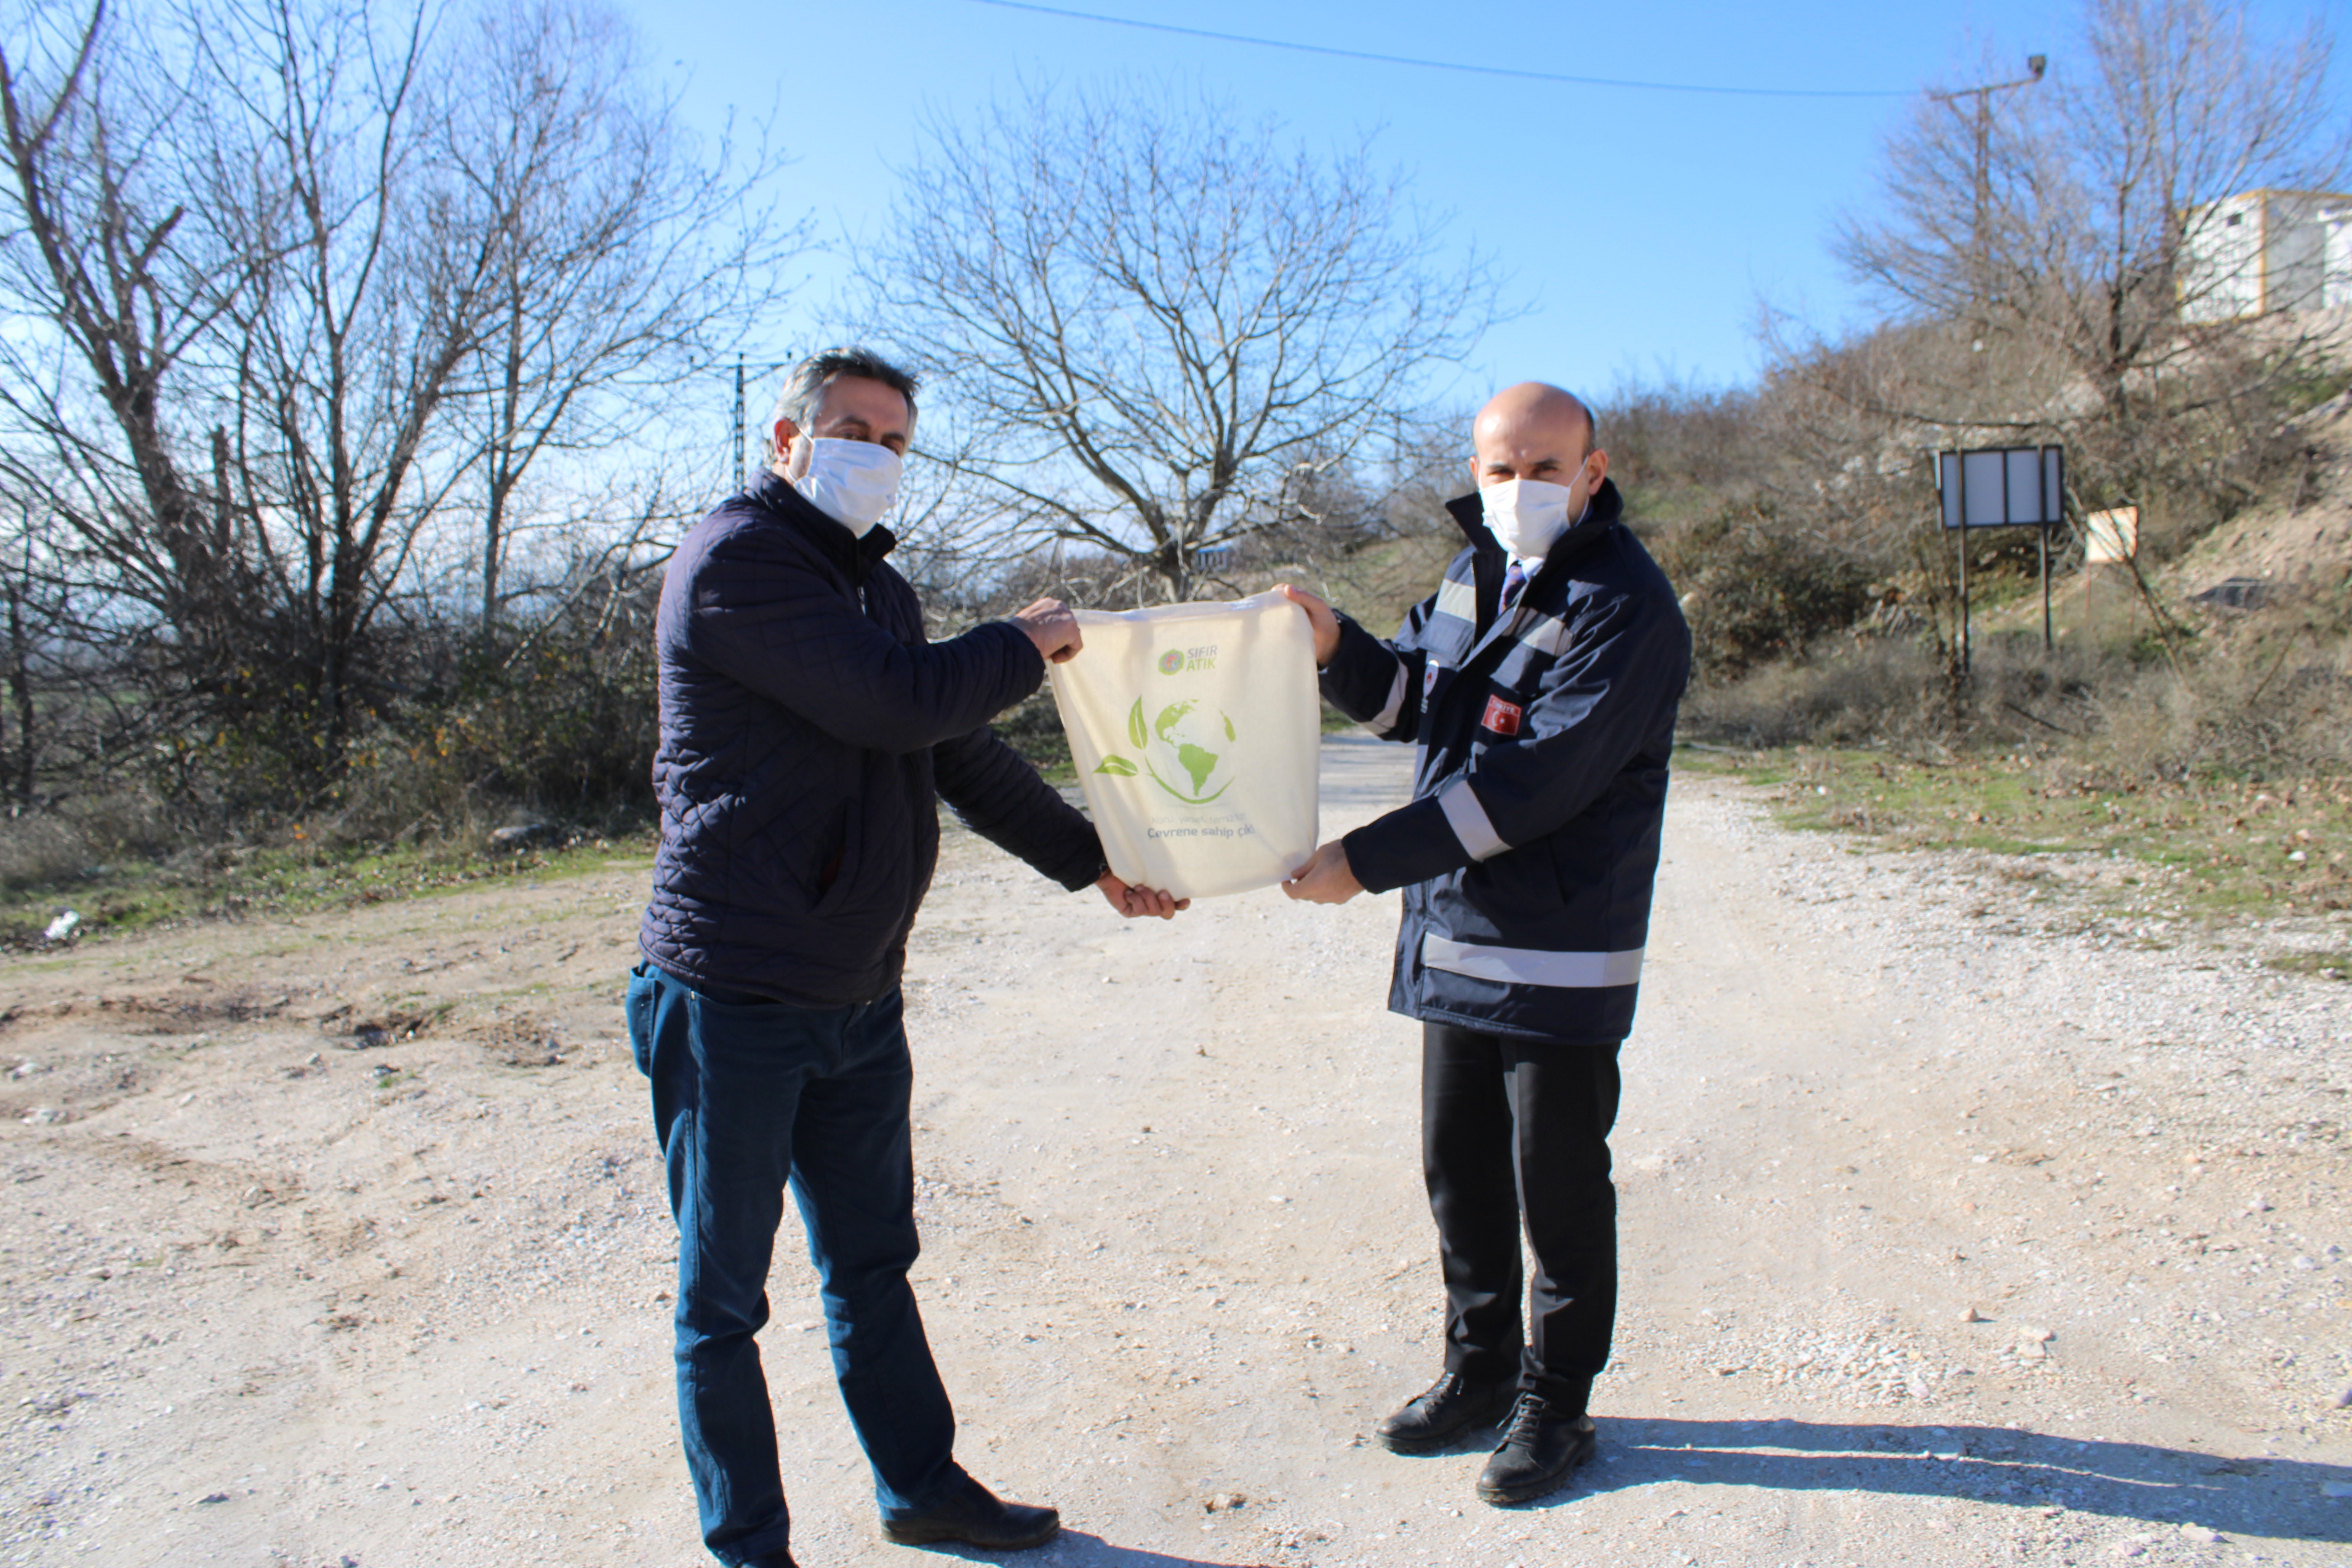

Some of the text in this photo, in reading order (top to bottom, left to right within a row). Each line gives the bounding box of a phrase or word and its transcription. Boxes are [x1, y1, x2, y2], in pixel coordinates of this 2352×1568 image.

[1187, 645, 1218, 659] SIFIR
[1185, 656, 1217, 672] ATIK
[1148, 827, 1198, 840] Çevrene
[1201, 826, 1234, 840] sahip
